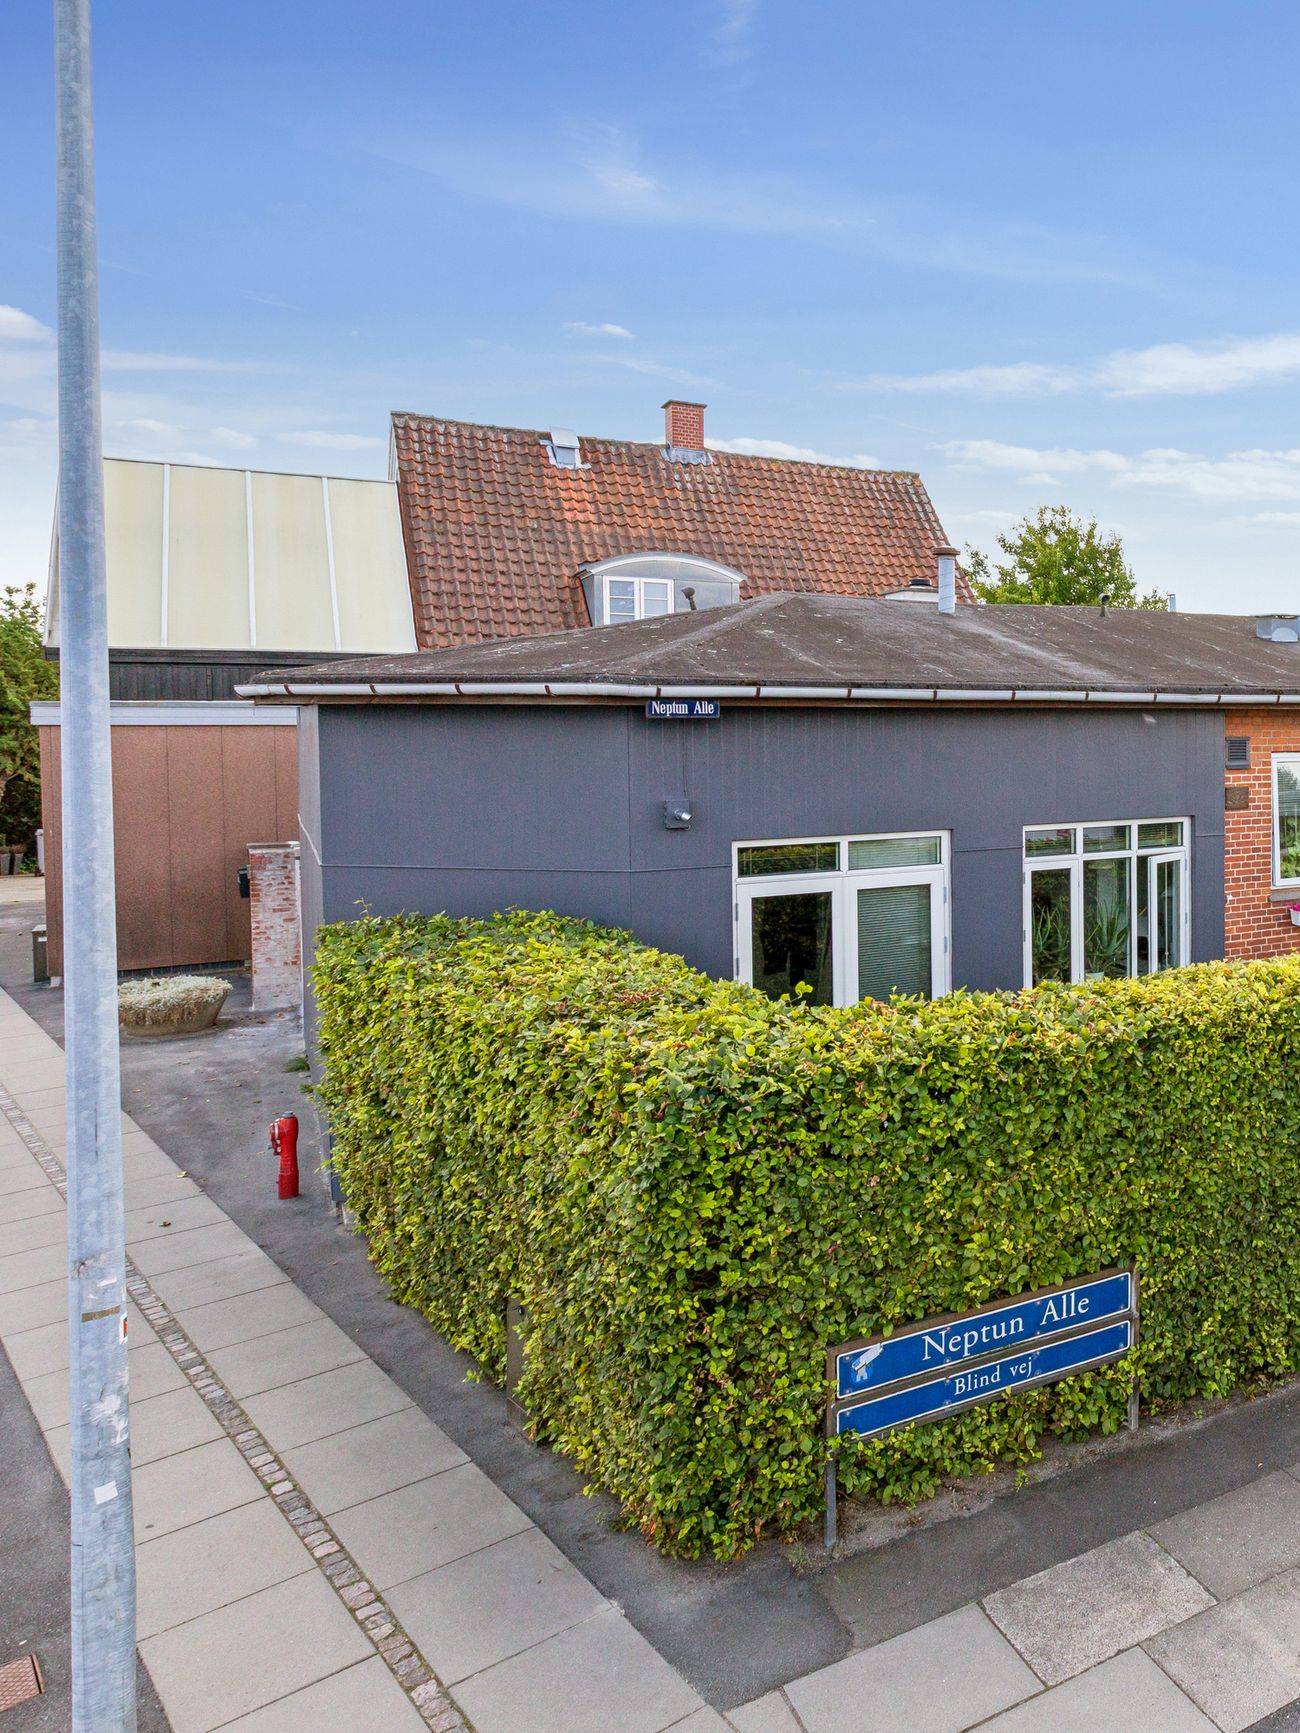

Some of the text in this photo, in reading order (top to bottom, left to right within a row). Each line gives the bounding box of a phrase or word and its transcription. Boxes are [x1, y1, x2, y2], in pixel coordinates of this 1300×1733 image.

[652, 700, 714, 716] Neptun Alle
[922, 1291, 1090, 1361] Neptun Alle
[954, 1356, 1033, 1396] Blind vej
